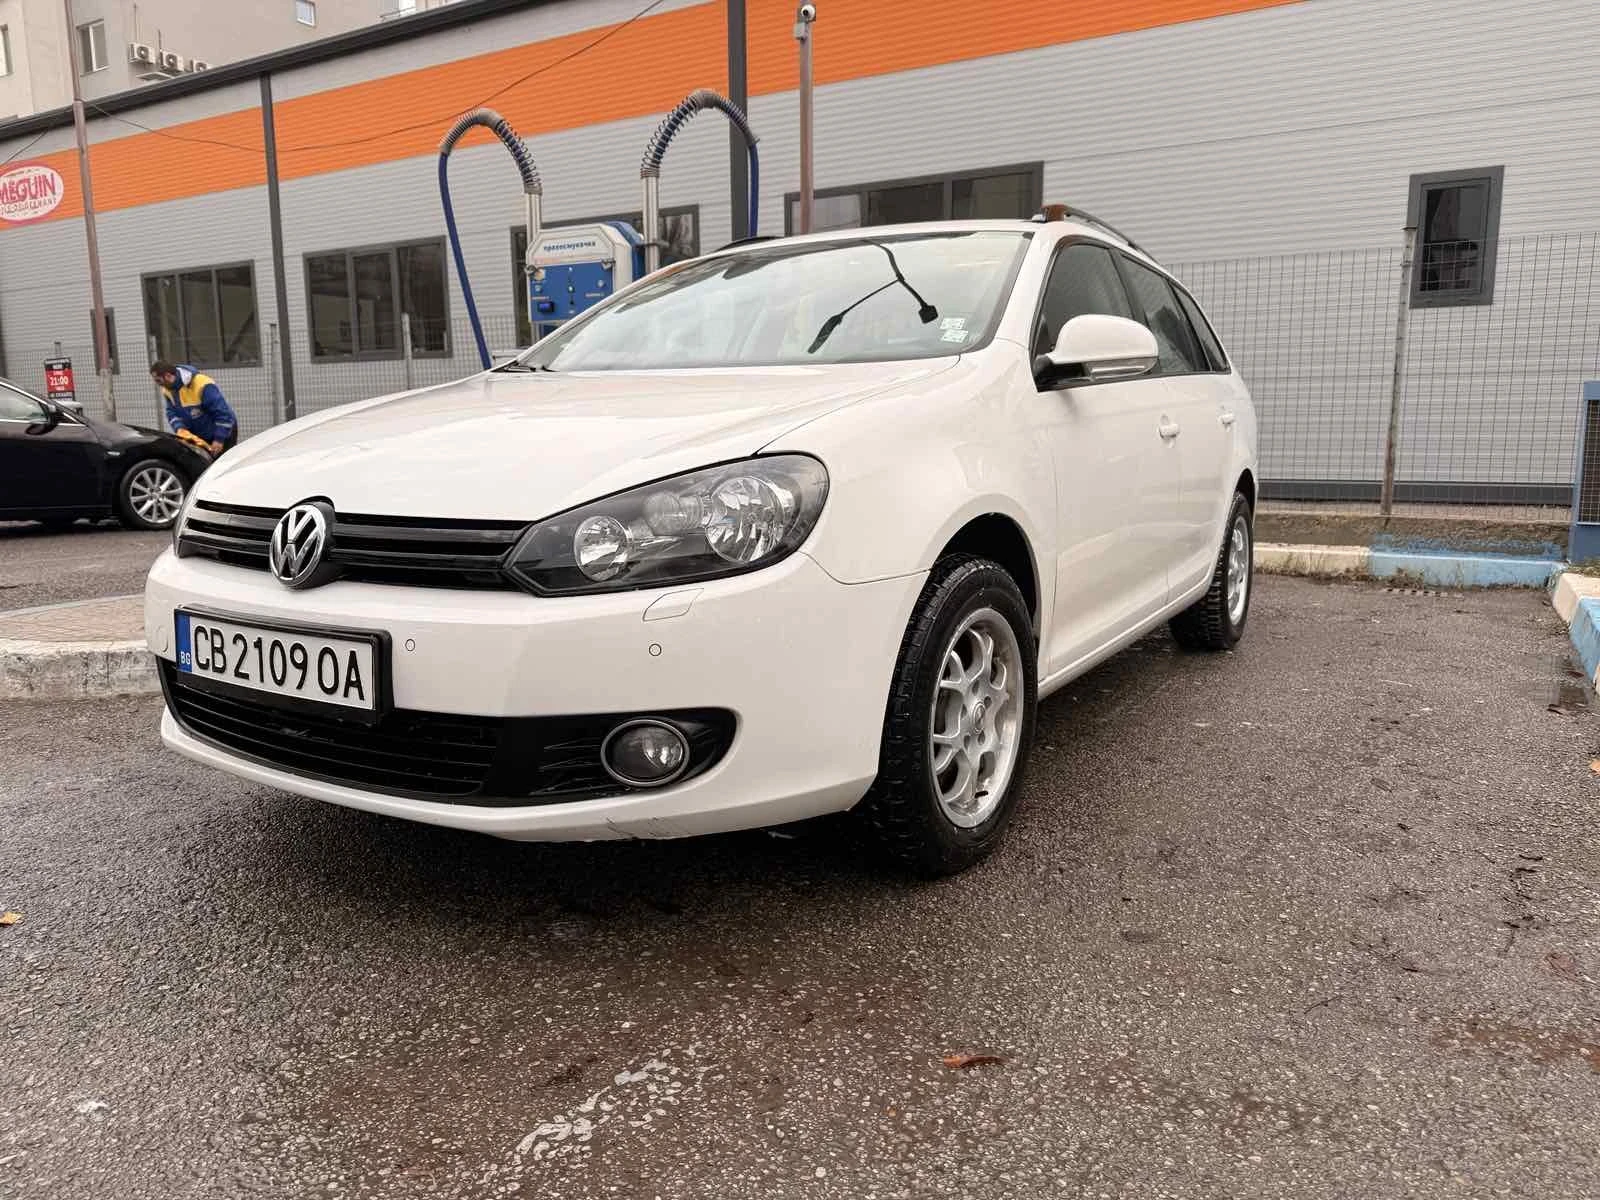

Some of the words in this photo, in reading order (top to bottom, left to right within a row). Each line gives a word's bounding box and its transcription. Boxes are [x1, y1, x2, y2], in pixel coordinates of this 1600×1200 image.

[180, 651, 191, 665] BG
[194, 625, 227, 674] CB
[232, 633, 308, 690] 2109
[317, 646, 365, 701] OA
